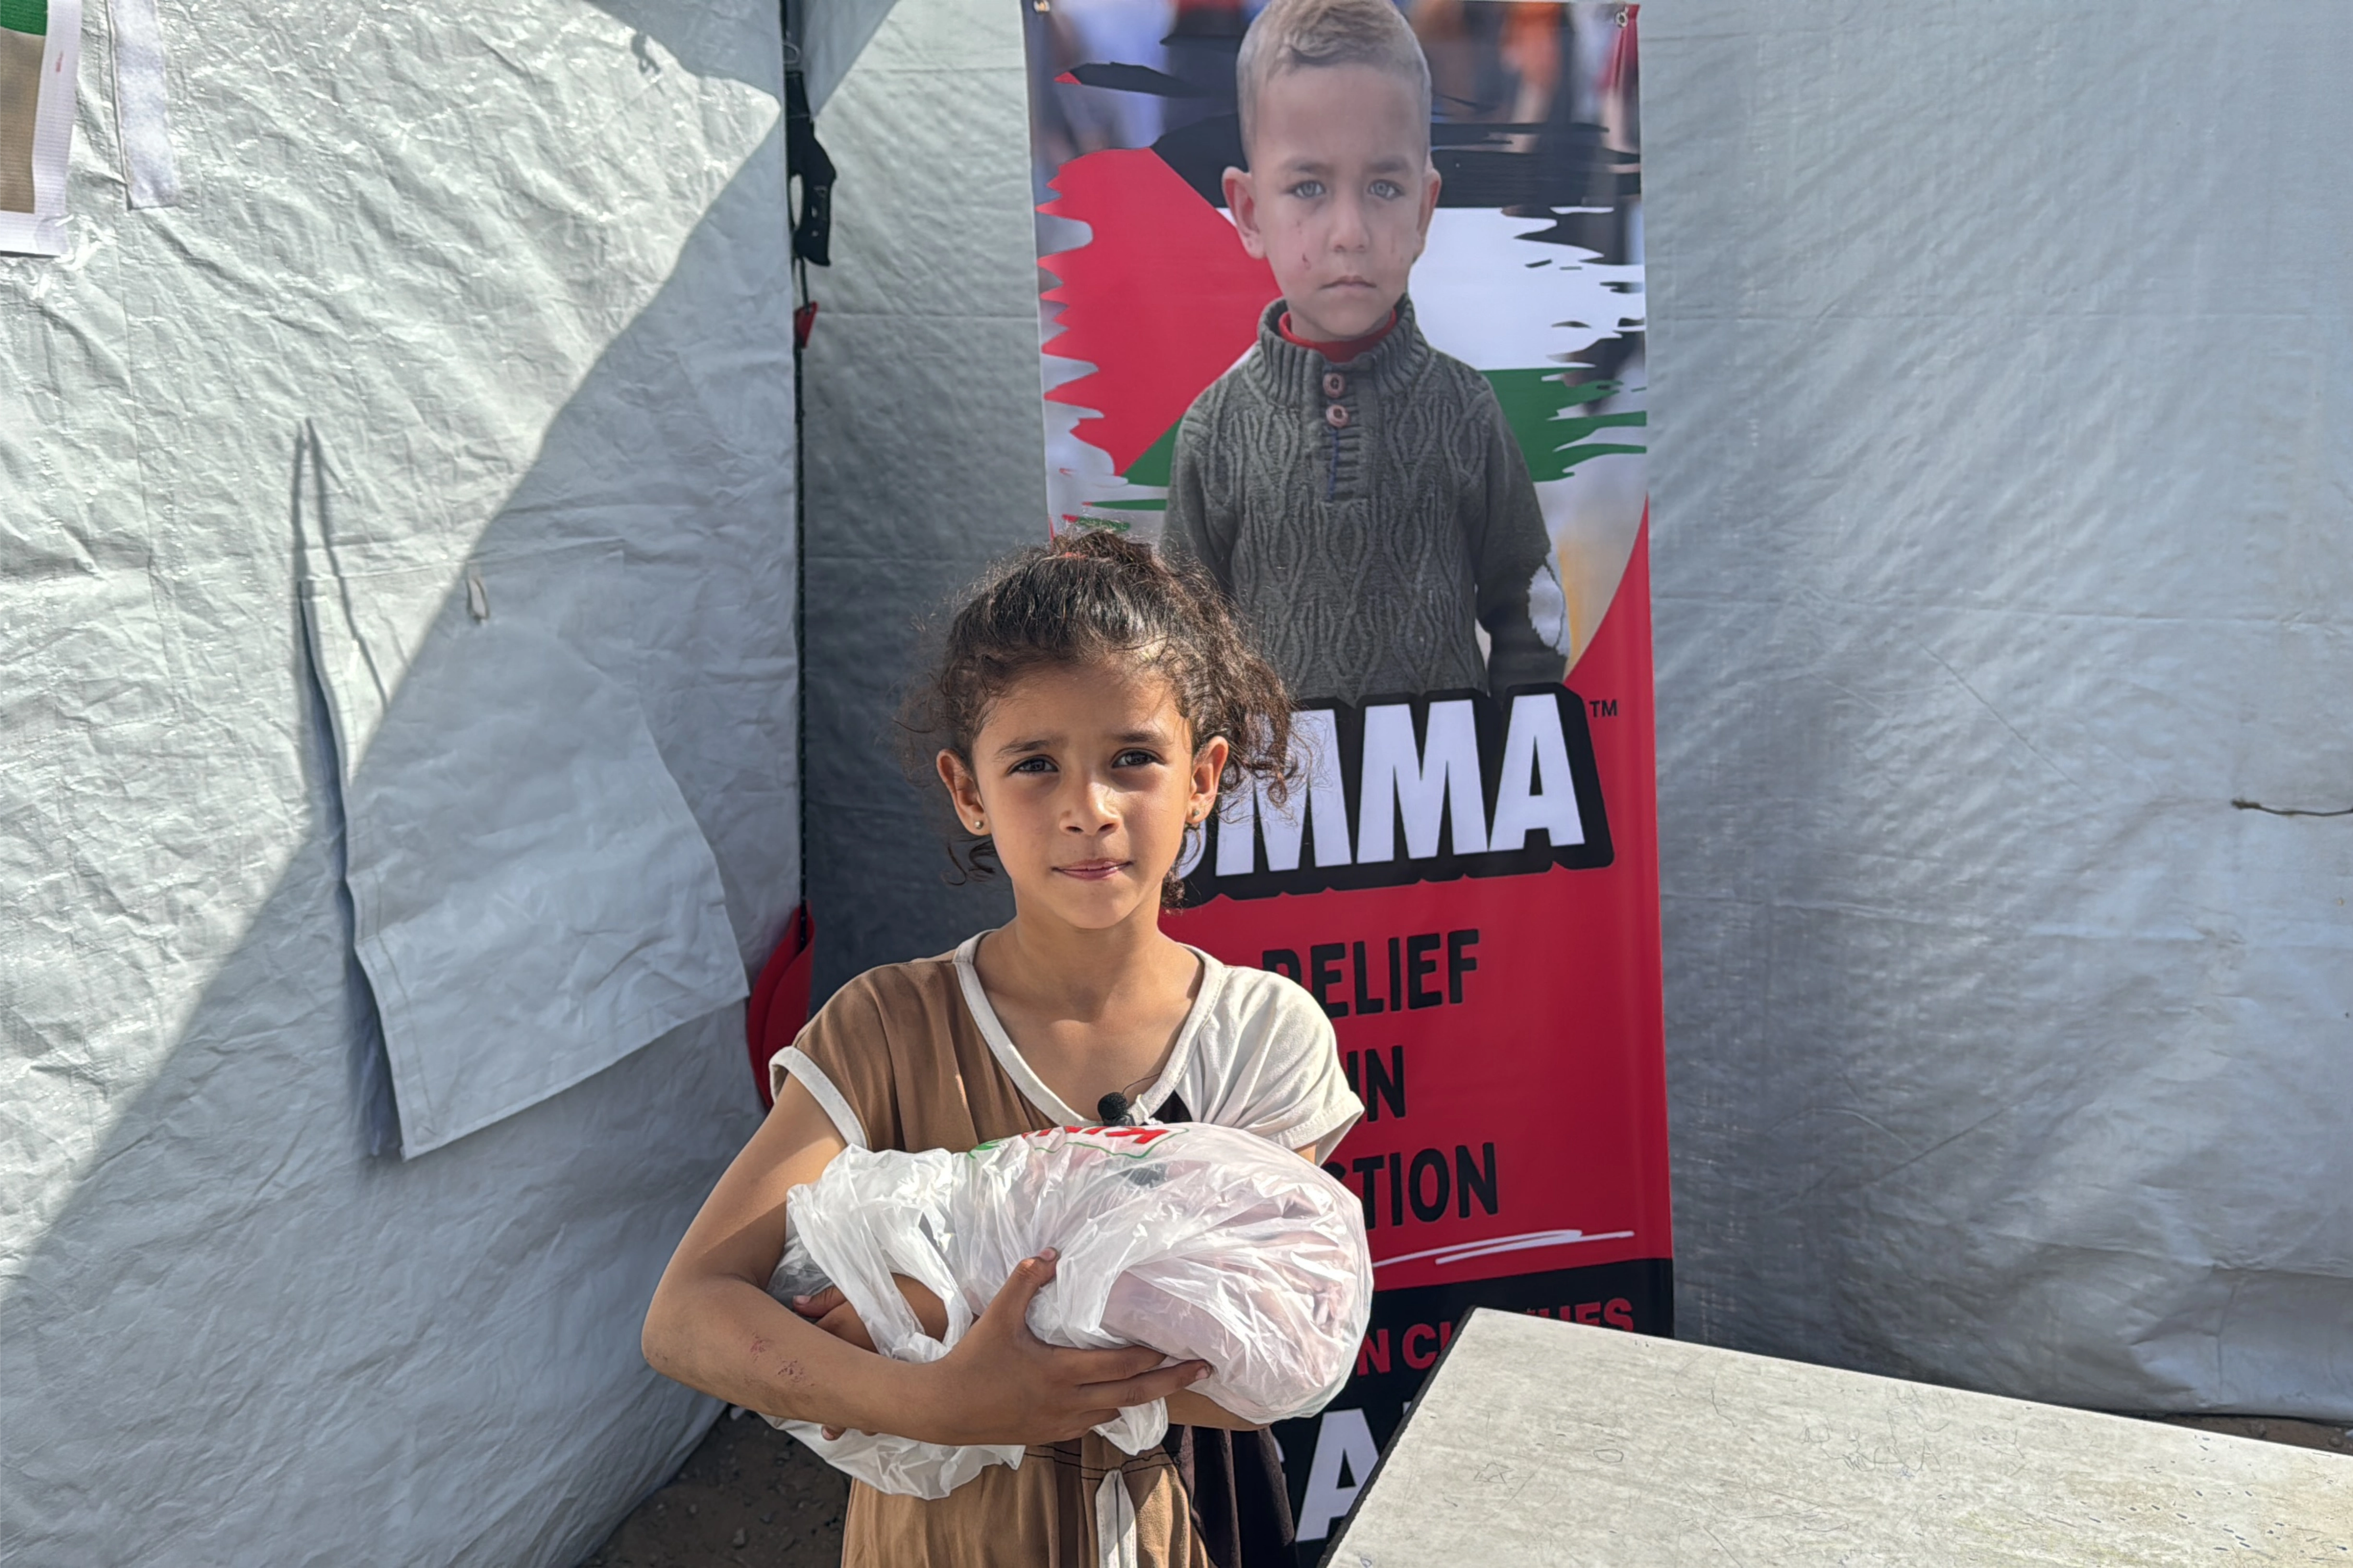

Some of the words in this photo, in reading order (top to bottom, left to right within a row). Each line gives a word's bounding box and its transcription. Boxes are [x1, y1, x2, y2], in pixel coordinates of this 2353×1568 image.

[1176, 693, 1585, 880] MMA
[1589, 699, 1617, 718] TM
[1321, 1142, 1498, 1230] TION
